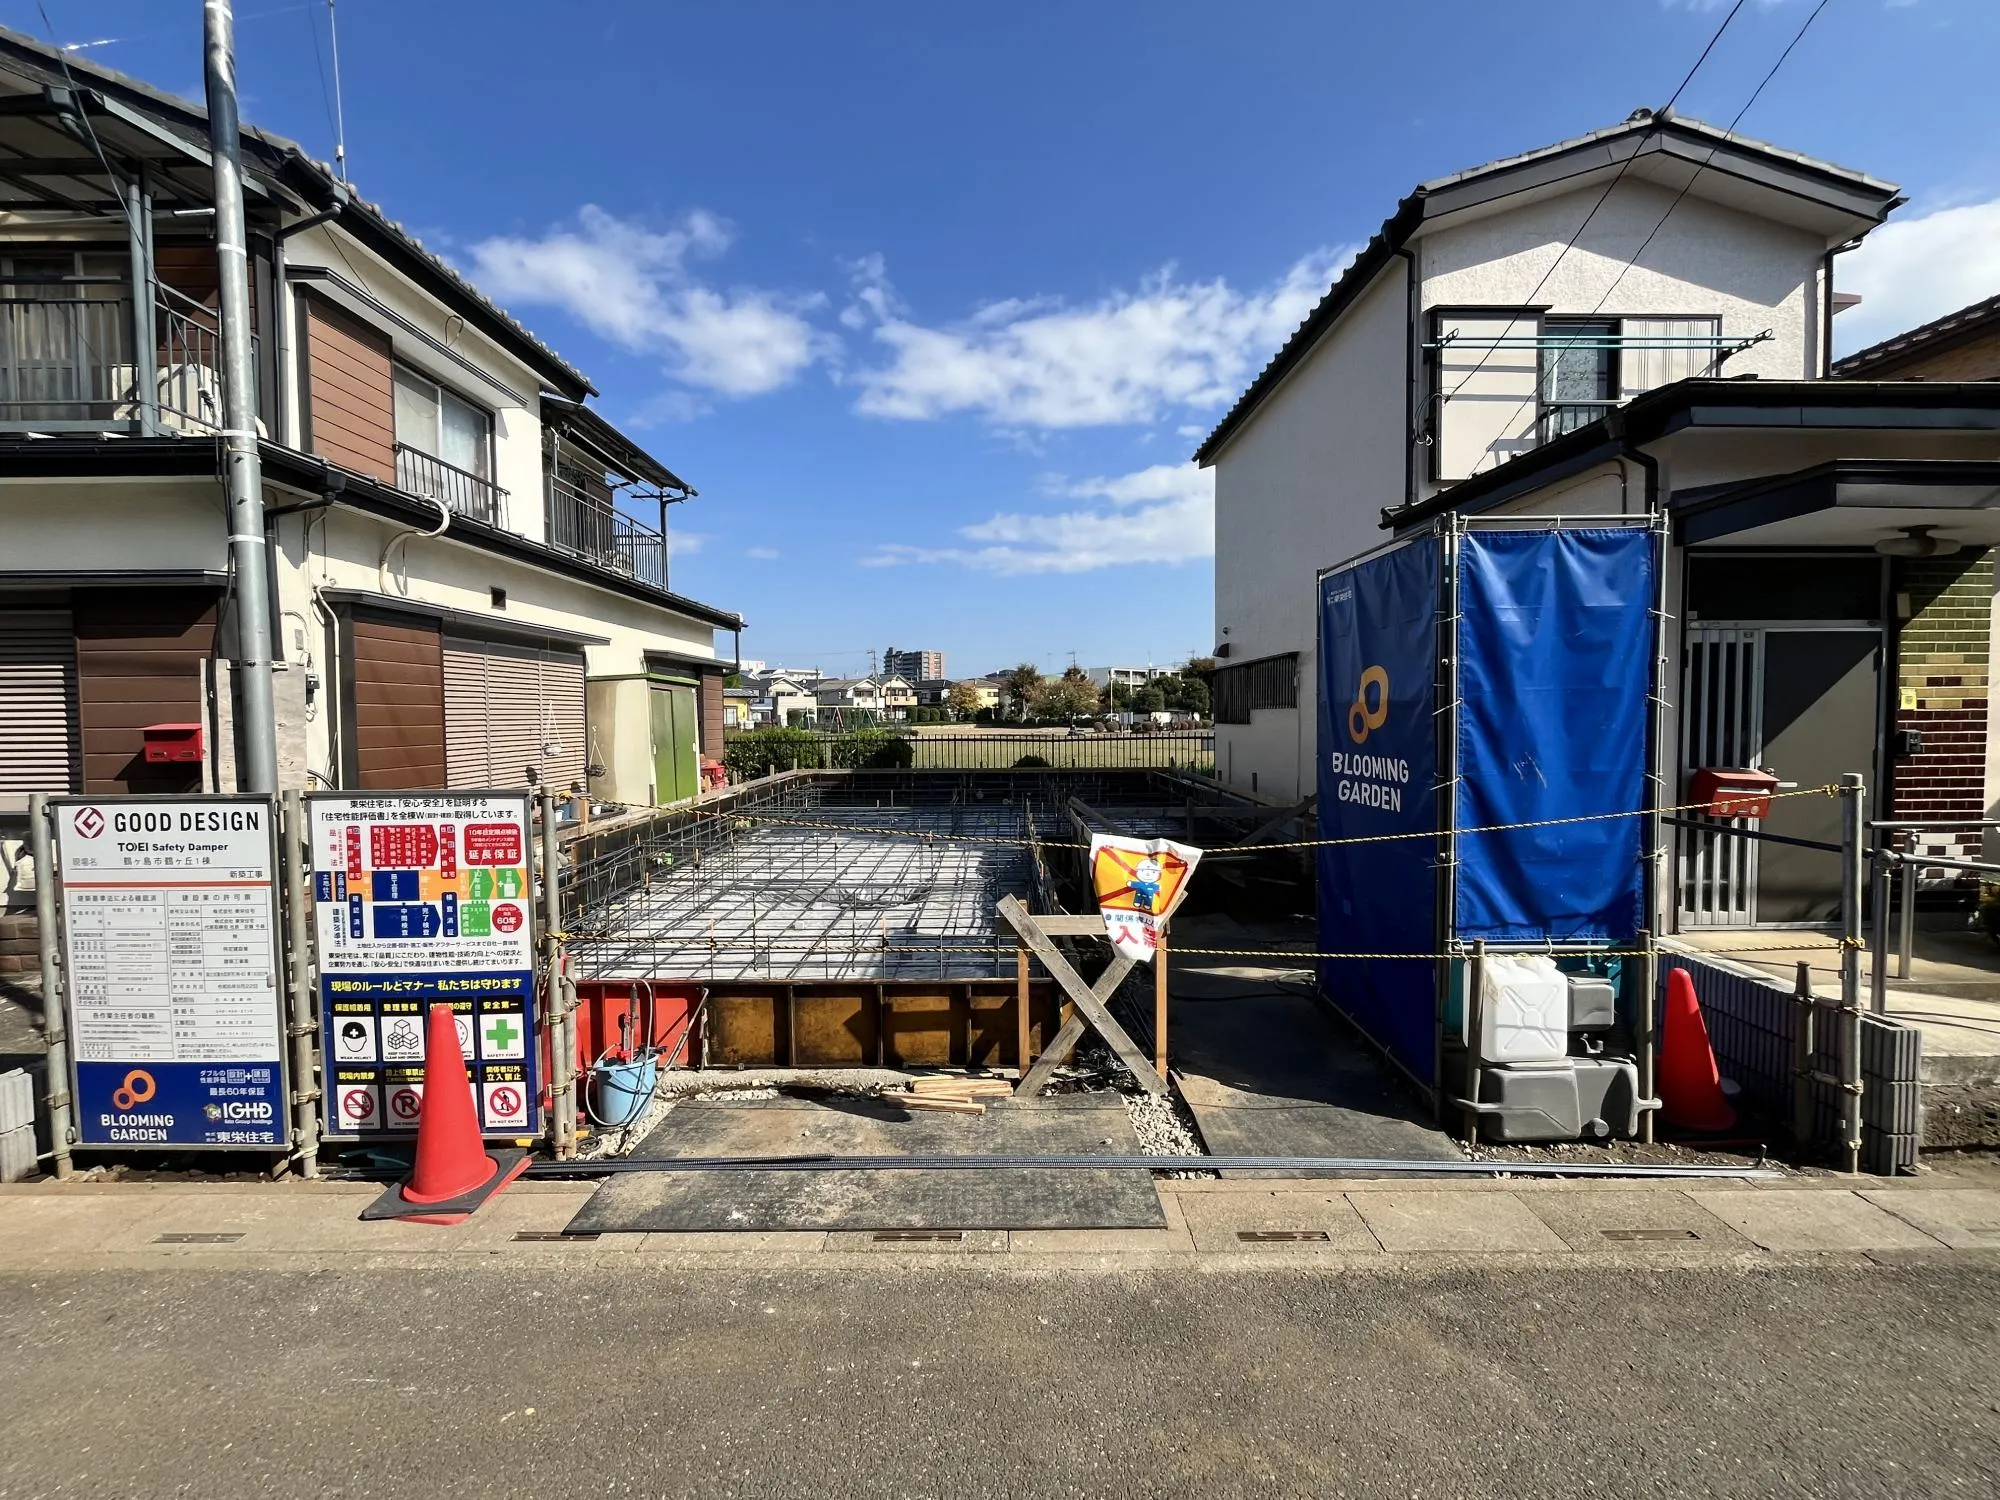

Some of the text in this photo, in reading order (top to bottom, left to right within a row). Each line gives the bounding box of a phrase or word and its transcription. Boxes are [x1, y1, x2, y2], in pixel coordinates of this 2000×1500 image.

[1332, 752, 1409, 783] BLOOMING
[1338, 779, 1401, 813] GARDEN
[114, 811, 259, 832] GOOD DESIGN
[152, 843, 185, 853] Safety
[188, 843, 228, 853] Damper
[468, 849, 518, 860] 延長保証
[229, 869, 263, 879] 新築工事
[496, 916, 517, 924] 60年
[331, 977, 522, 992] 現場のルールとマナー 私たちは守ります
[483, 1001, 519, 1010] 安全第一
[487, 1073, 522, 1081] 立入禁止
[209, 1087, 265, 1096] 最長60年保証
[223, 1102, 273, 1118] IGHD
[101, 1114, 174, 1127] BLOOMING
[110, 1128, 167, 1141] GARDEN
[216, 1131, 274, 1143] 東栄住宅
